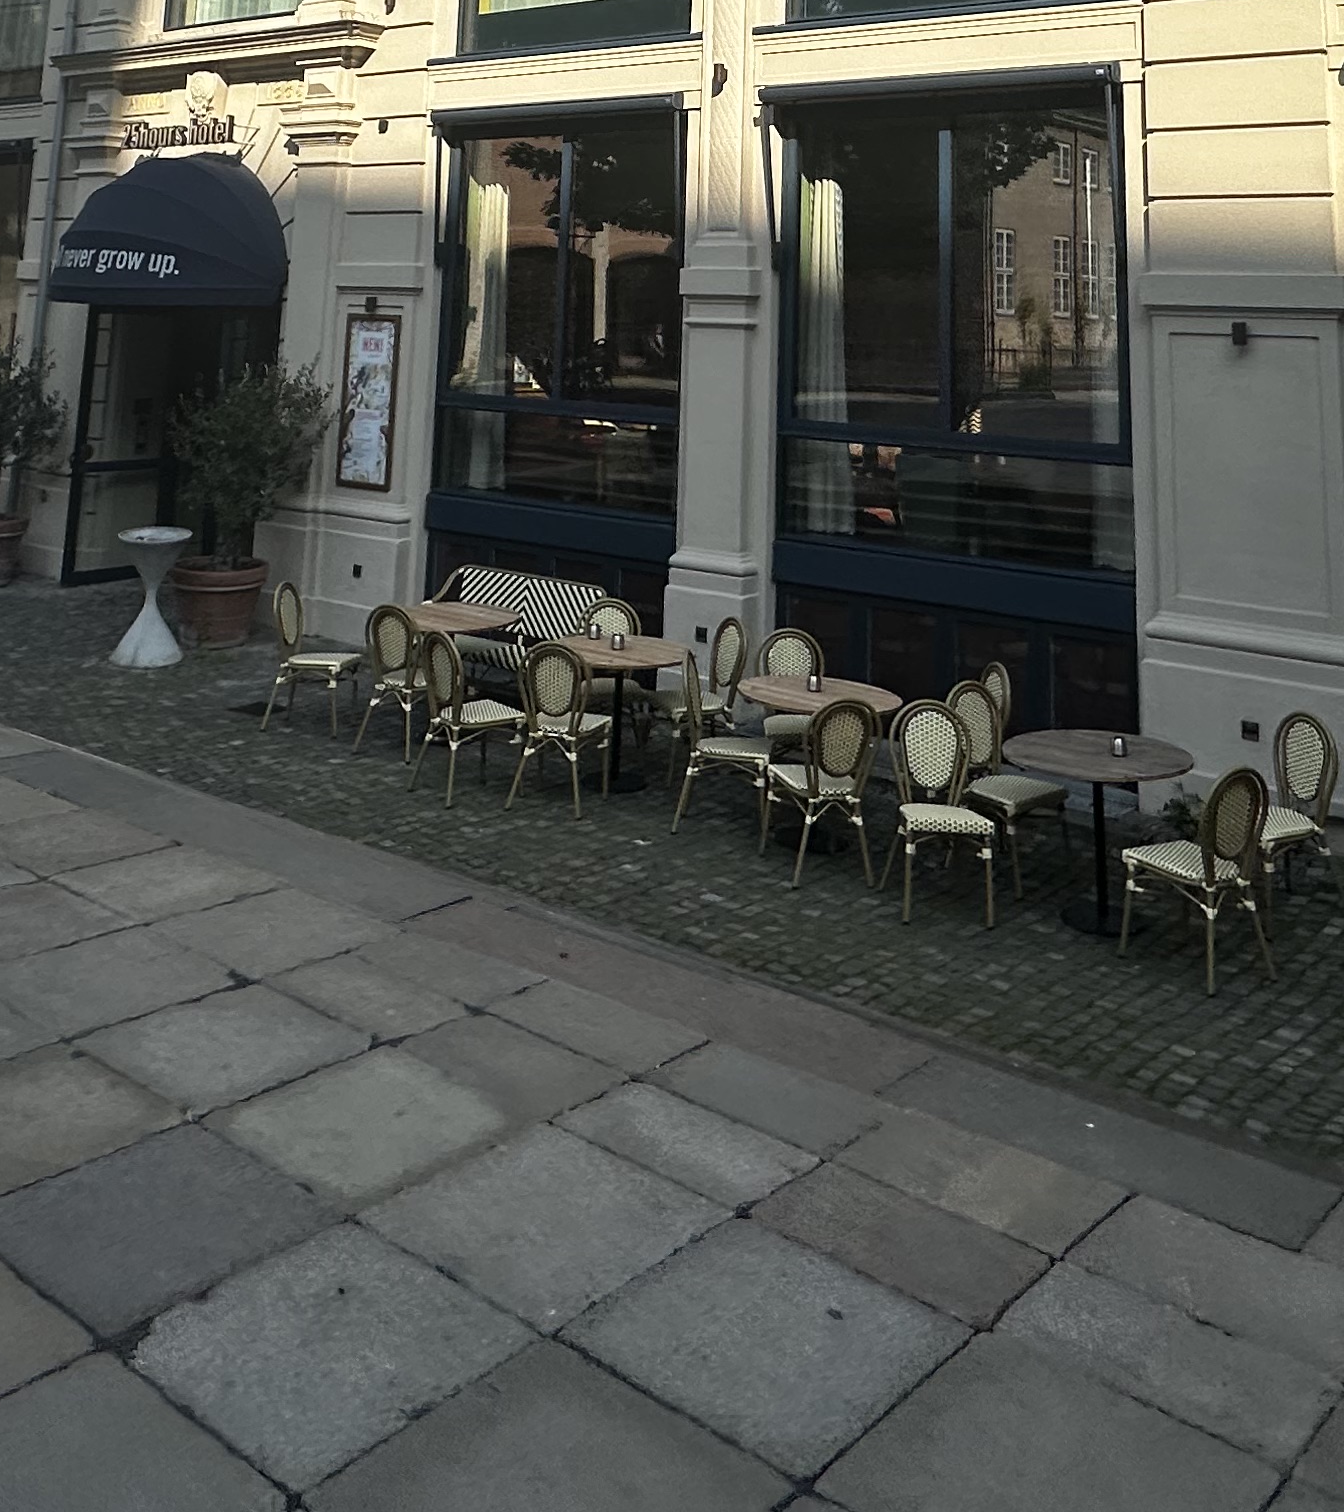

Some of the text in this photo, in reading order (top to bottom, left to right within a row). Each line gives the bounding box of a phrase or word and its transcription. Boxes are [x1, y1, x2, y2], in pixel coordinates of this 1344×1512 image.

[120, 114, 235, 150] 25hours hotel
[95, 248, 145, 274] grow
[148, 252, 180, 279] up.
